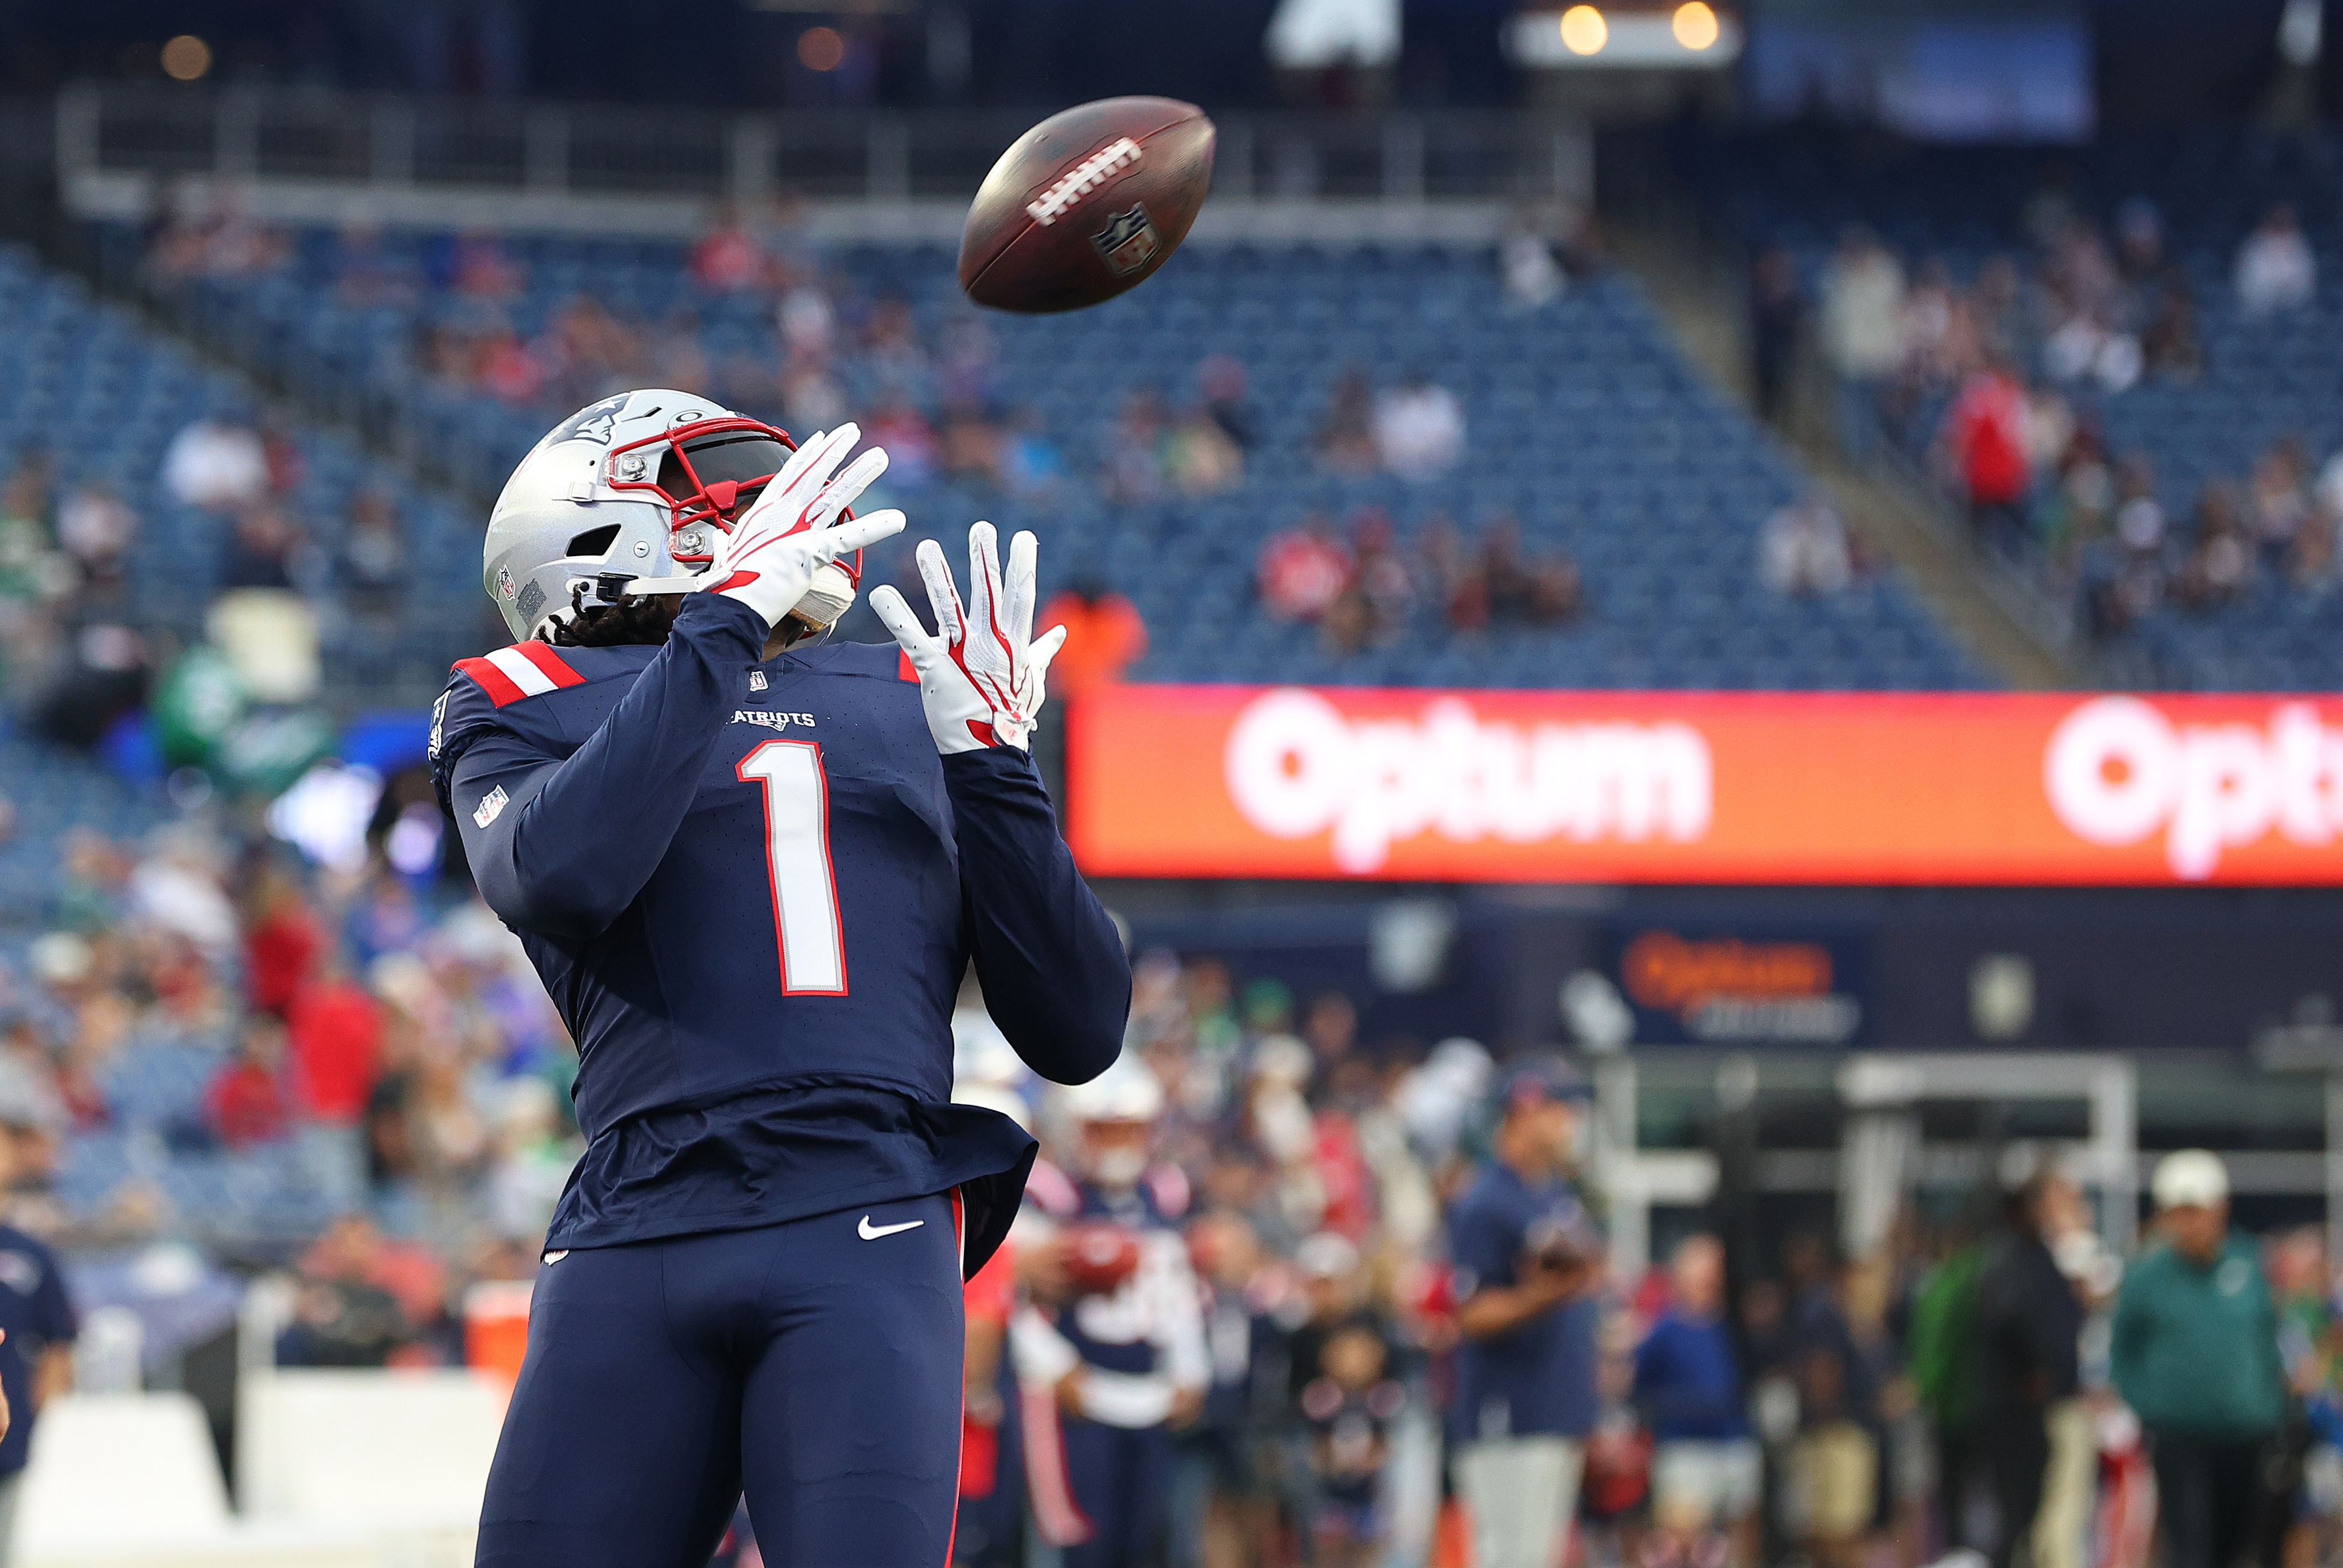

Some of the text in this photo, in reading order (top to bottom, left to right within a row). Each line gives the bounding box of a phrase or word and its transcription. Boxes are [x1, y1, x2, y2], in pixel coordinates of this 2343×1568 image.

[729, 710, 816, 728] ATRIOTS
[1226, 691, 1712, 869] Optum
[2045, 697, 2343, 874] Opt
[482, 798, 505, 822] NFL
[735, 739, 848, 997] 1
